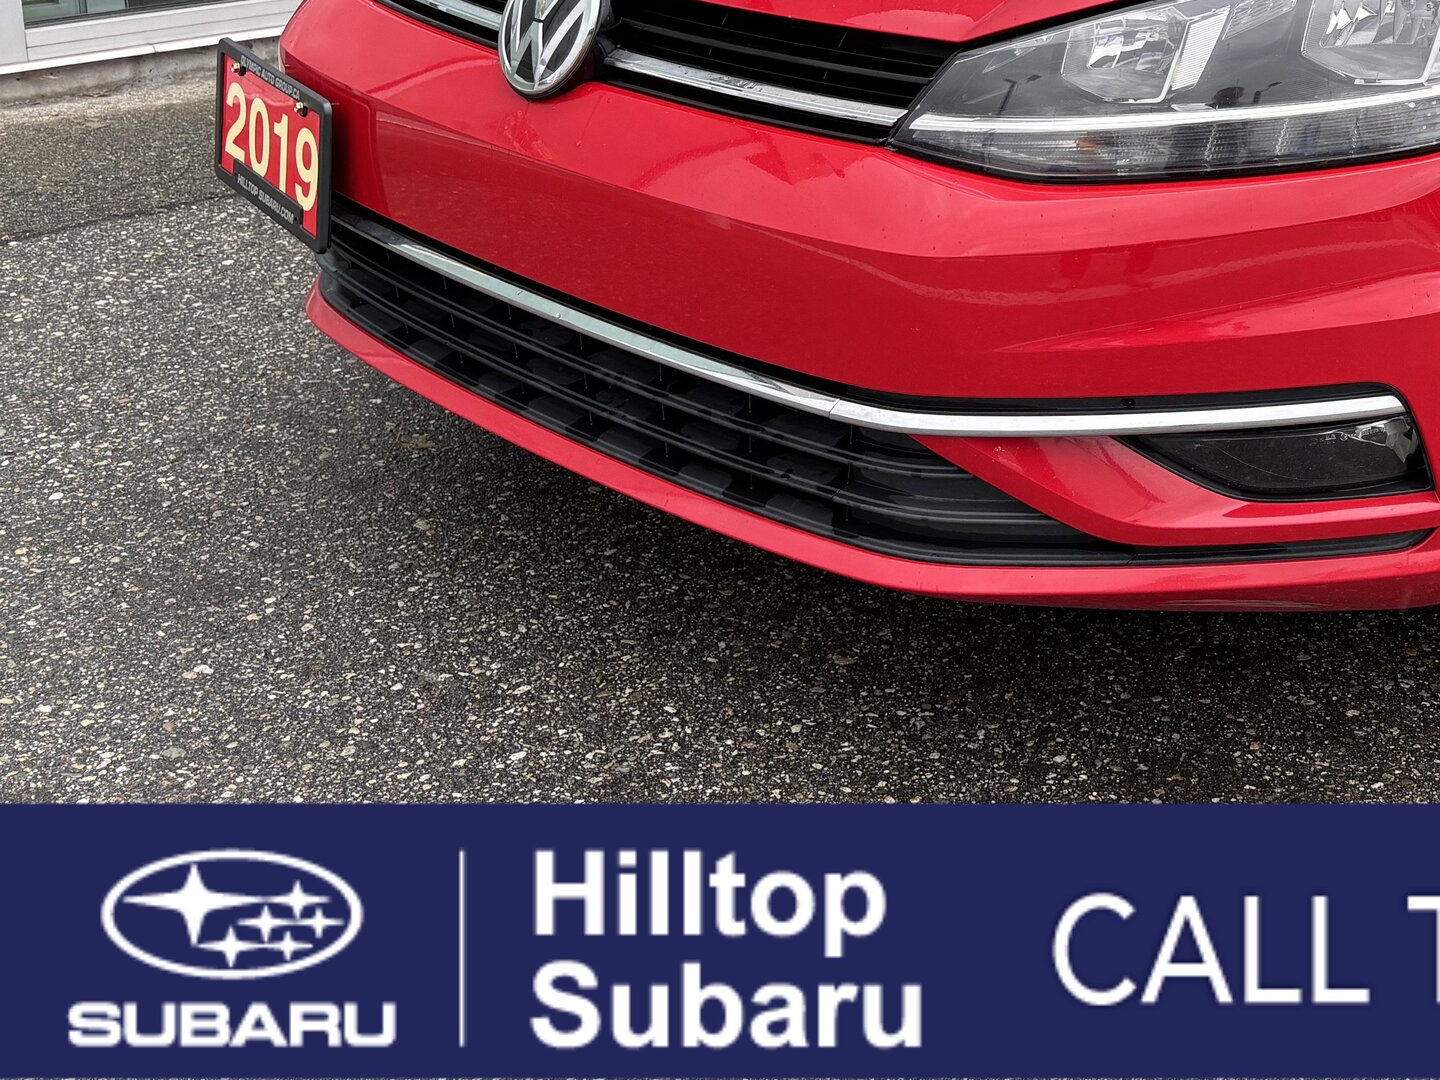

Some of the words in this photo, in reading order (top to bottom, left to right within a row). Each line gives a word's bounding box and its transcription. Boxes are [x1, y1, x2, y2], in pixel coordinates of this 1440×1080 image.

[240, 54, 261, 76] OLYMPIC
[261, 69, 275, 86] AUTO
[275, 78, 301, 101] GROUP.CA
[225, 82, 319, 211] 2019
[237, 173, 259, 196] HILLTOP
[258, 189, 294, 224] SUBARU.COM
